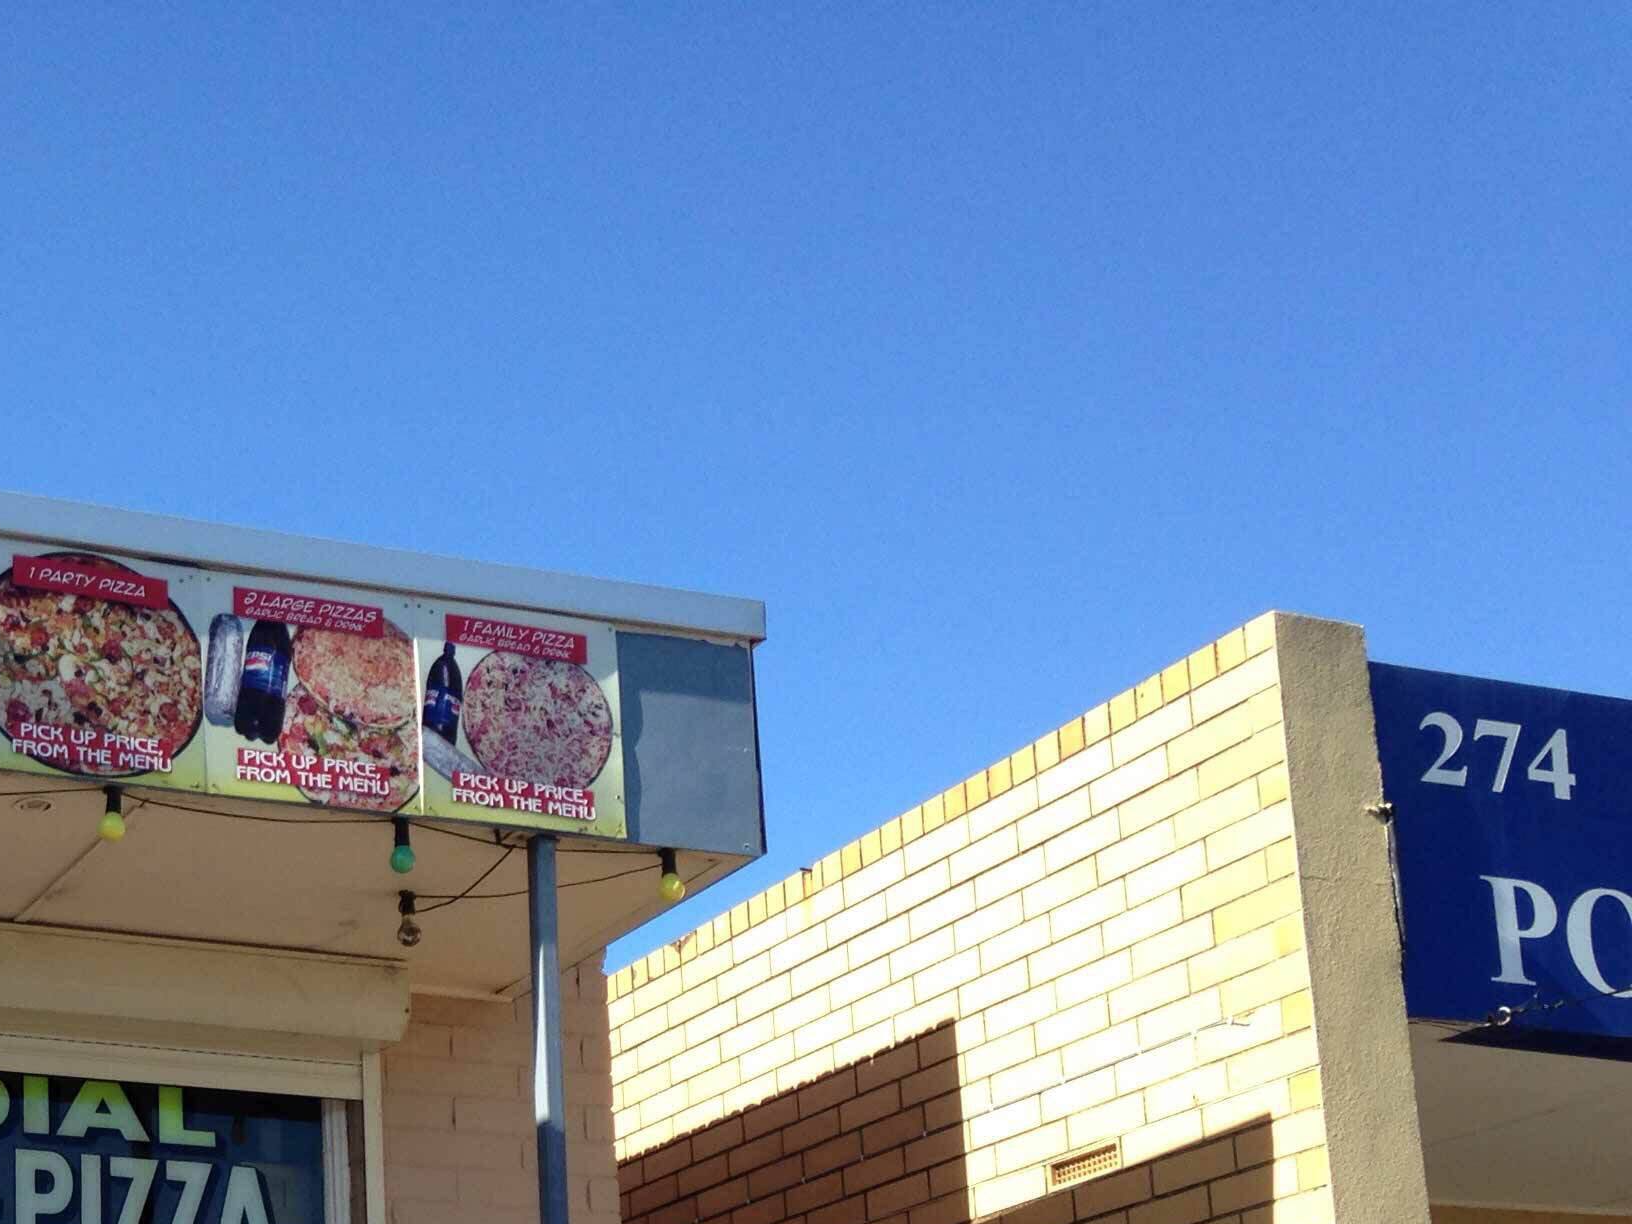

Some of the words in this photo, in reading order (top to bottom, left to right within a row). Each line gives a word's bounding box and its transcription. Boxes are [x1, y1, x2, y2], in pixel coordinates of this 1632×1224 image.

[39, 568, 96, 587] PARTY
[98, 578, 145, 597] PIZZA
[245, 606, 283, 619] GARLIC
[260, 594, 315, 613] LARGE
[319, 603, 377, 623] PIZZAS
[473, 621, 529, 640] FAMILY
[531, 631, 575, 649] PIZZA
[20, 723, 63, 741] PICK
[70, 730, 96, 745] UP
[104, 733, 163, 756] PRICE,
[12, 738, 68, 759] FROM
[76, 746, 112, 765] THE
[119, 753, 172, 772] MENU
[243, 750, 286, 767] PICK
[291, 754, 317, 770] UP
[323, 758, 381, 780] PRICE,
[1419, 711, 1577, 800] 274
[236, 765, 291, 784] FROM
[297, 771, 333, 788] THE
[338, 776, 389, 795] MENU
[459, 772, 499, 791] PICK
[504, 778, 528, 795] UP
[534, 783, 588, 805] PRICE,
[452, 788, 504, 808] FROM
[509, 795, 543, 813] THE
[548, 801, 596, 820] MENU
